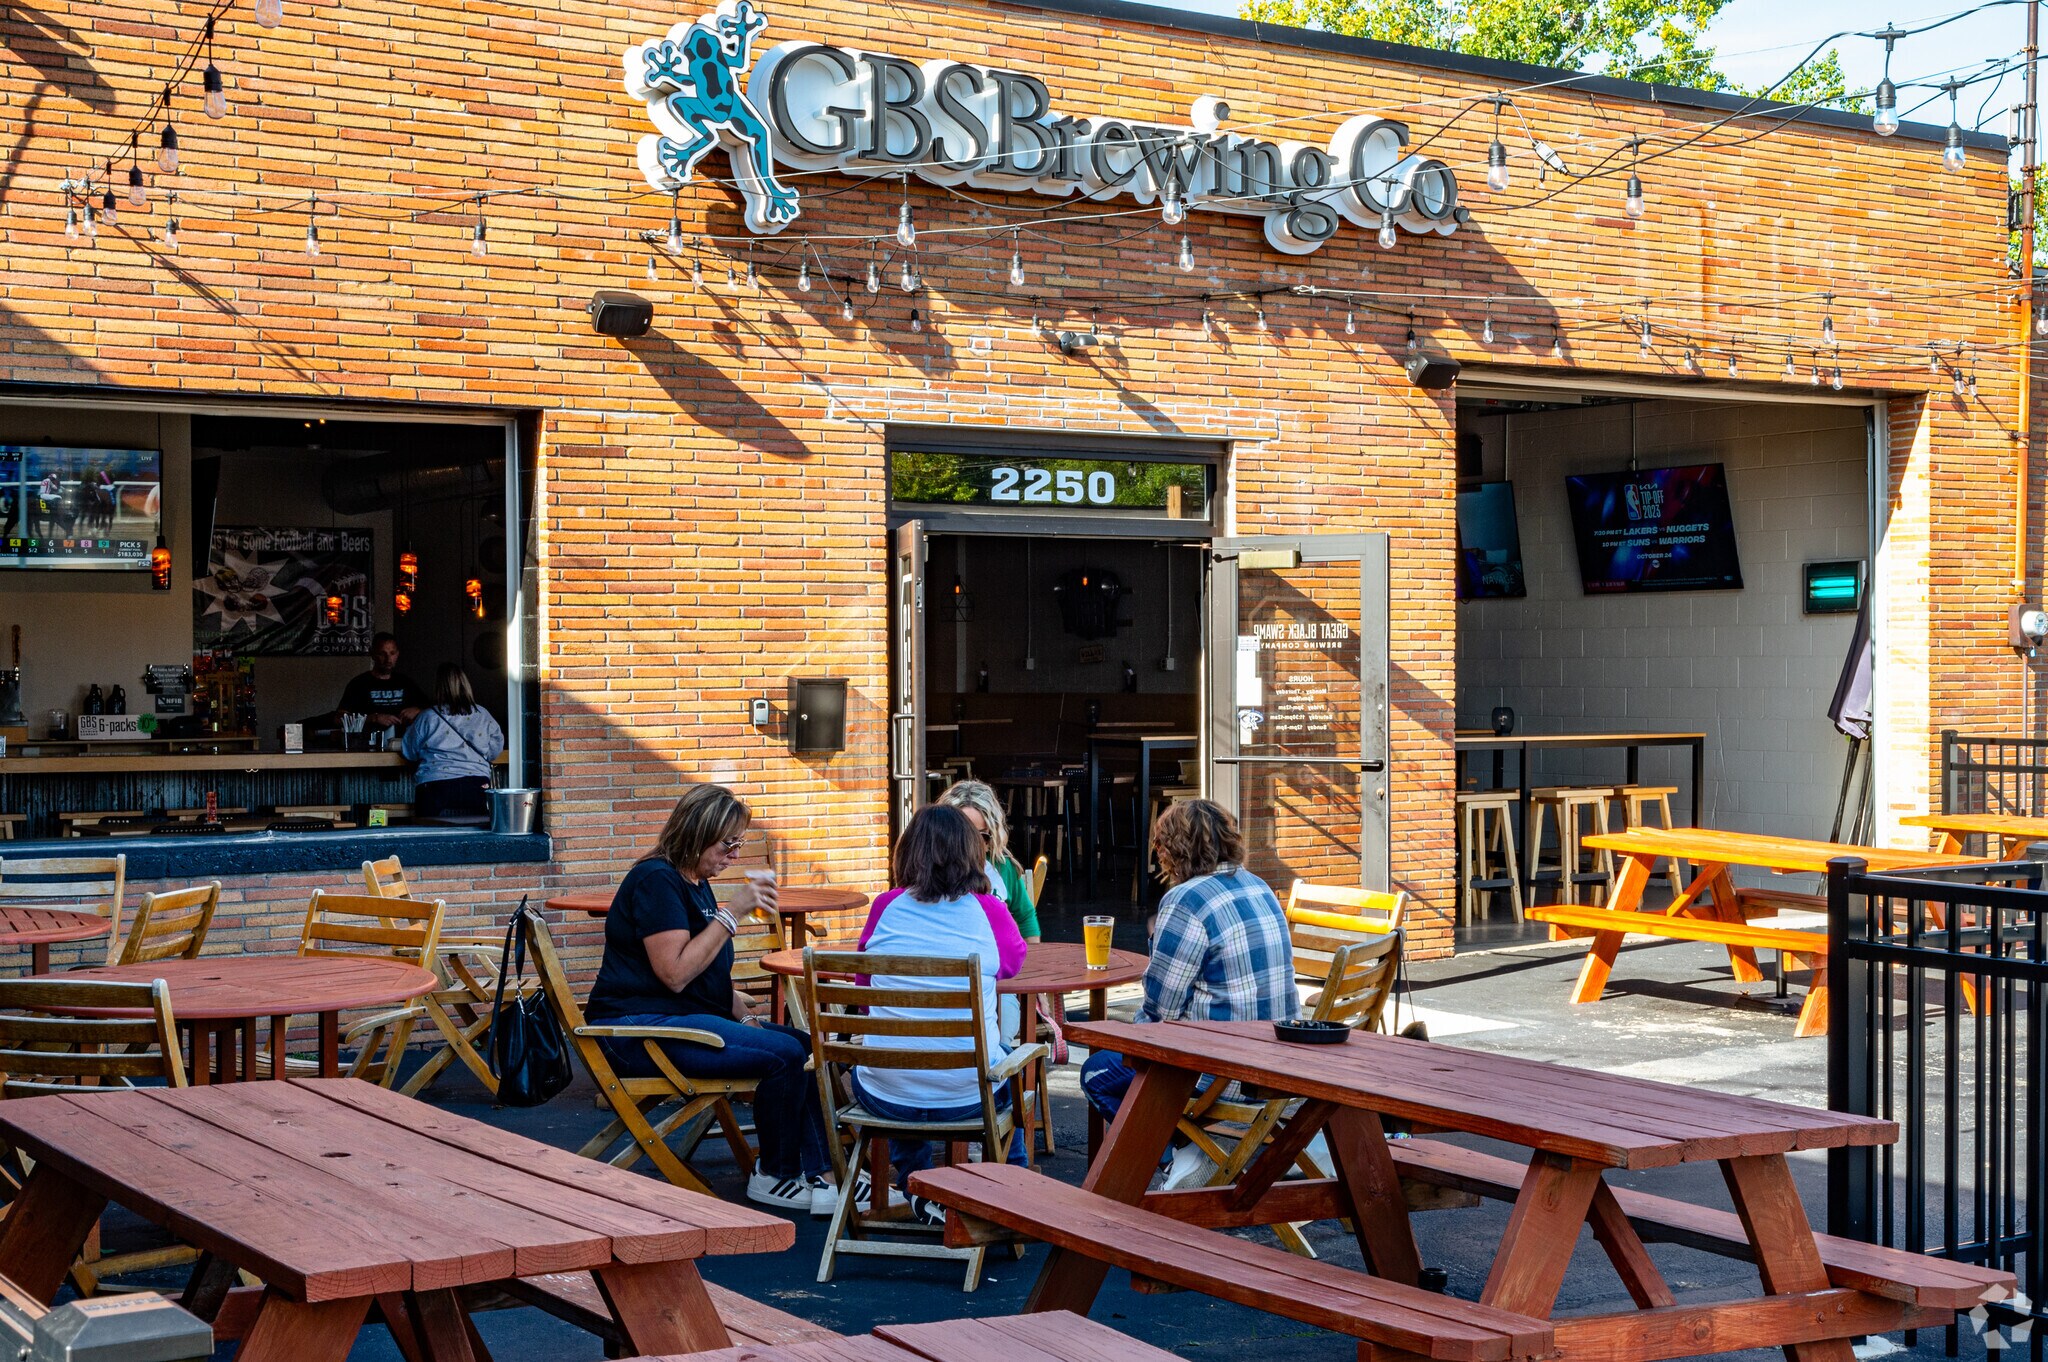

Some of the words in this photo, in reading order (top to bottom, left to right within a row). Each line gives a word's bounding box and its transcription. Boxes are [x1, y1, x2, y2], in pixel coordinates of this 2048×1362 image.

[990, 467, 1116, 505] 2250
[40, 500, 46, 508] 6
[1640, 490, 1664, 504] TIP-OFF
[1643, 504, 1661, 518] 2023
[1623, 526, 1658, 535] LAKERS
[1666, 523, 1709, 533] NUGGETS
[226, 532, 239, 550] for
[242, 535, 270, 551] some
[274, 531, 314, 552] Football
[317, 532, 335, 551] and
[342, 532, 370, 552] Beers
[1627, 538, 1650, 546] SUNS
[1659, 535, 1706, 545] WARRIORS
[1482, 574, 1516, 584] NAVAGE
[80, 716, 97, 728] GBS
[99, 718, 137, 735] 6-packs
